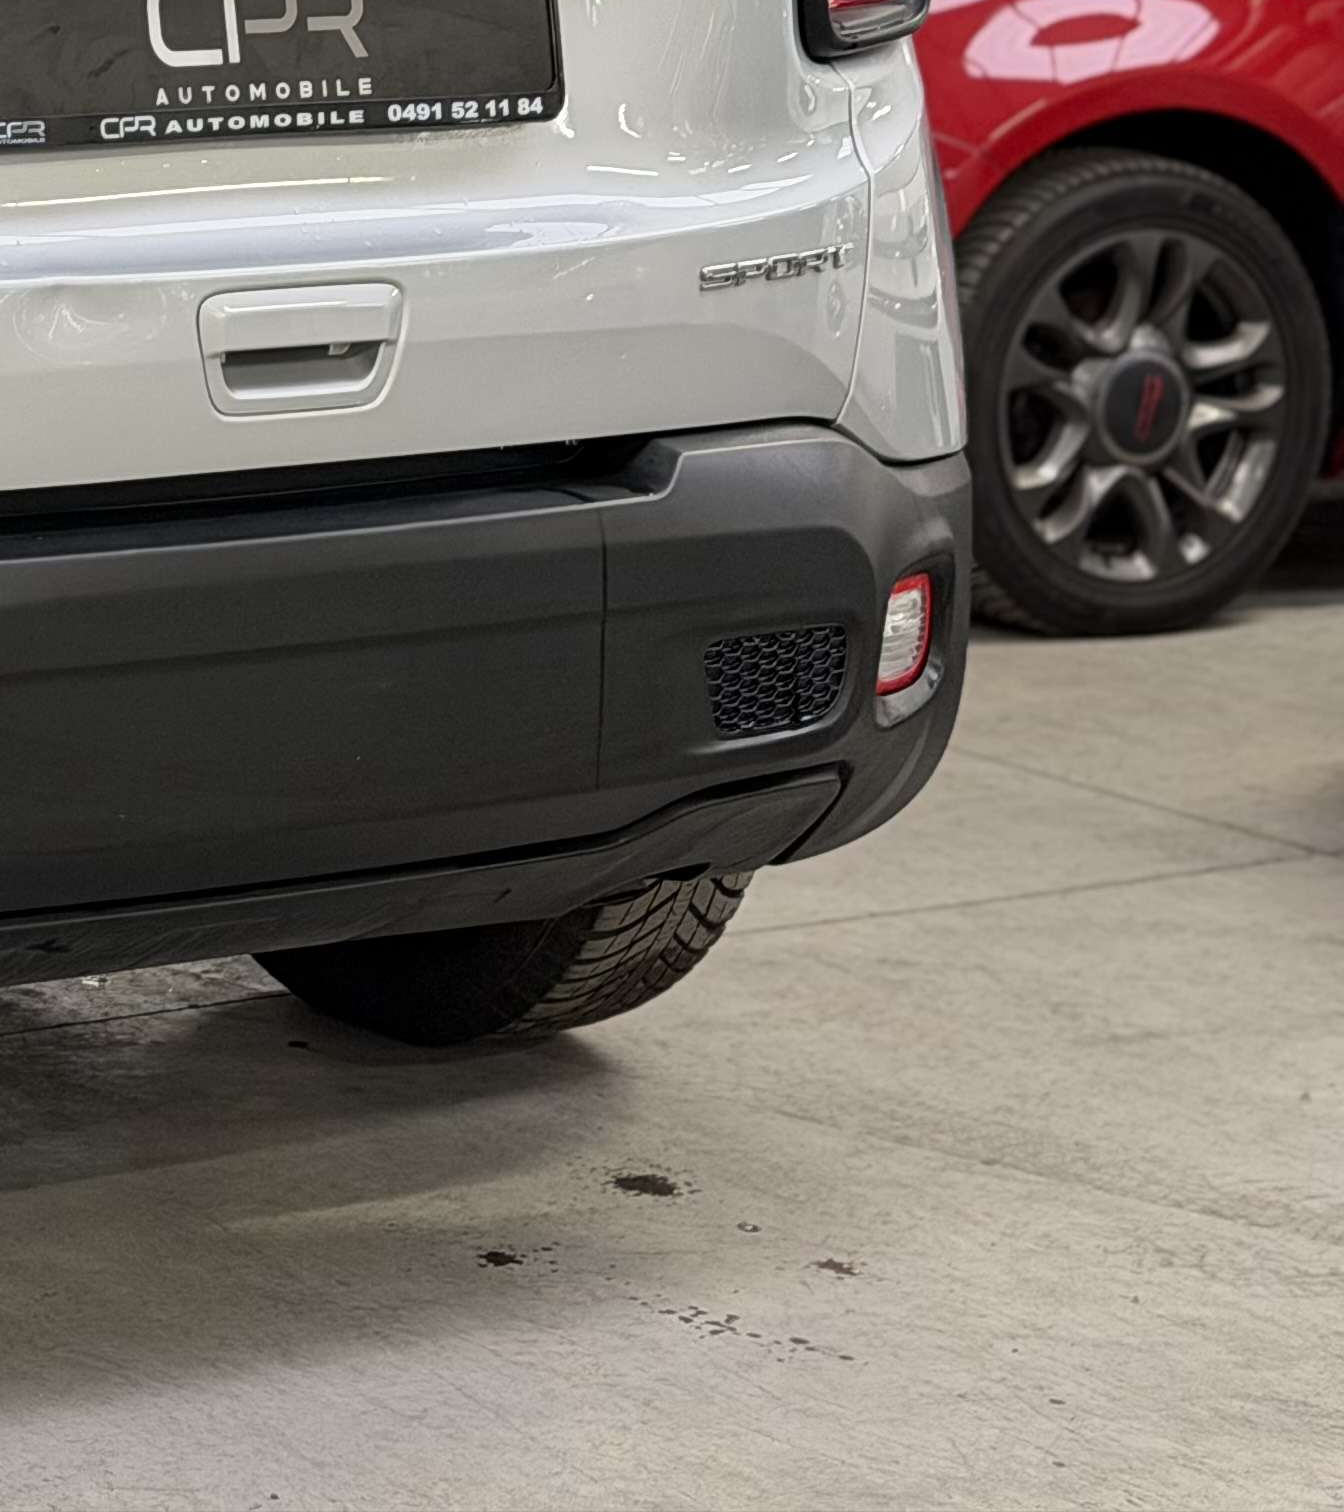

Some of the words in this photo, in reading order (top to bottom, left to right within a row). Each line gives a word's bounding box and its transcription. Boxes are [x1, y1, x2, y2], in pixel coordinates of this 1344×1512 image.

[155, 77, 373, 106] AUTOMOBILE
[100, 115, 157, 140] CPR
[164, 109, 366, 135] AUTOMOBILE
[387, 101, 443, 122] 0491
[451, 100, 479, 120] 52
[485, 98, 510, 118] 11
[517, 96, 544, 116] 84
[699, 242, 855, 292] SPORT
